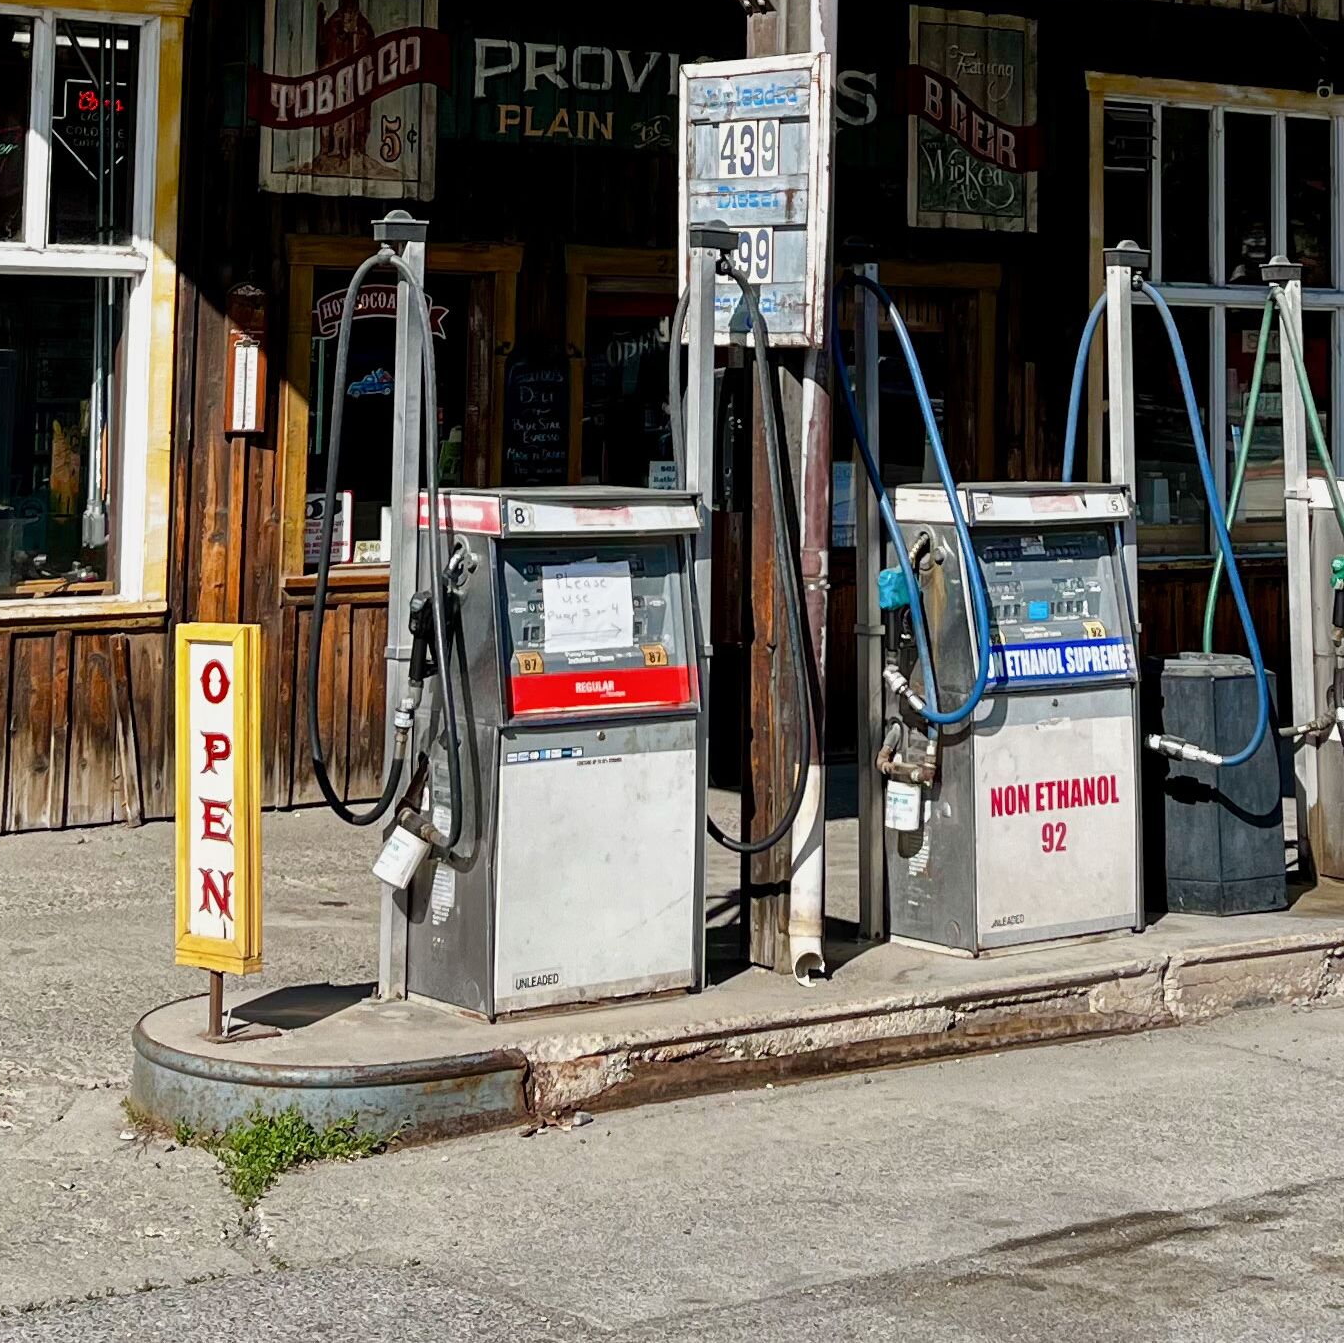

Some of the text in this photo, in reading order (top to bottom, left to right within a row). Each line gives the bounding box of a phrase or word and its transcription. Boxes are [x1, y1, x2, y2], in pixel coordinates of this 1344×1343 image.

[271, 35, 421, 122] TOBACCO
[473, 37, 878, 126] PROVIS
[497, 104, 616, 141] PLAIN
[924, 74, 1017, 168] BEER
[720, 119, 777, 176] 439
[920, 144, 1014, 204] Wicked
[717, 185, 779, 209] Diesel
[728, 228, 773, 280] 99
[514, 507, 525, 524] 8
[1111, 499, 1119, 511] 5
[1091, 627, 1103, 638] 92
[524, 658, 538, 671] 87
[648, 651, 662, 663] 87
[1005, 646, 1065, 676] ETHANOL
[1065, 643, 1128, 673] SUPREME
[575, 680, 615, 694] REGULAR
[199, 658, 234, 921] OPEN
[990, 774, 1119, 818] NON ETHANOL
[1042, 821, 1067, 853] 92
[515, 972, 559, 990] UNLEADED
